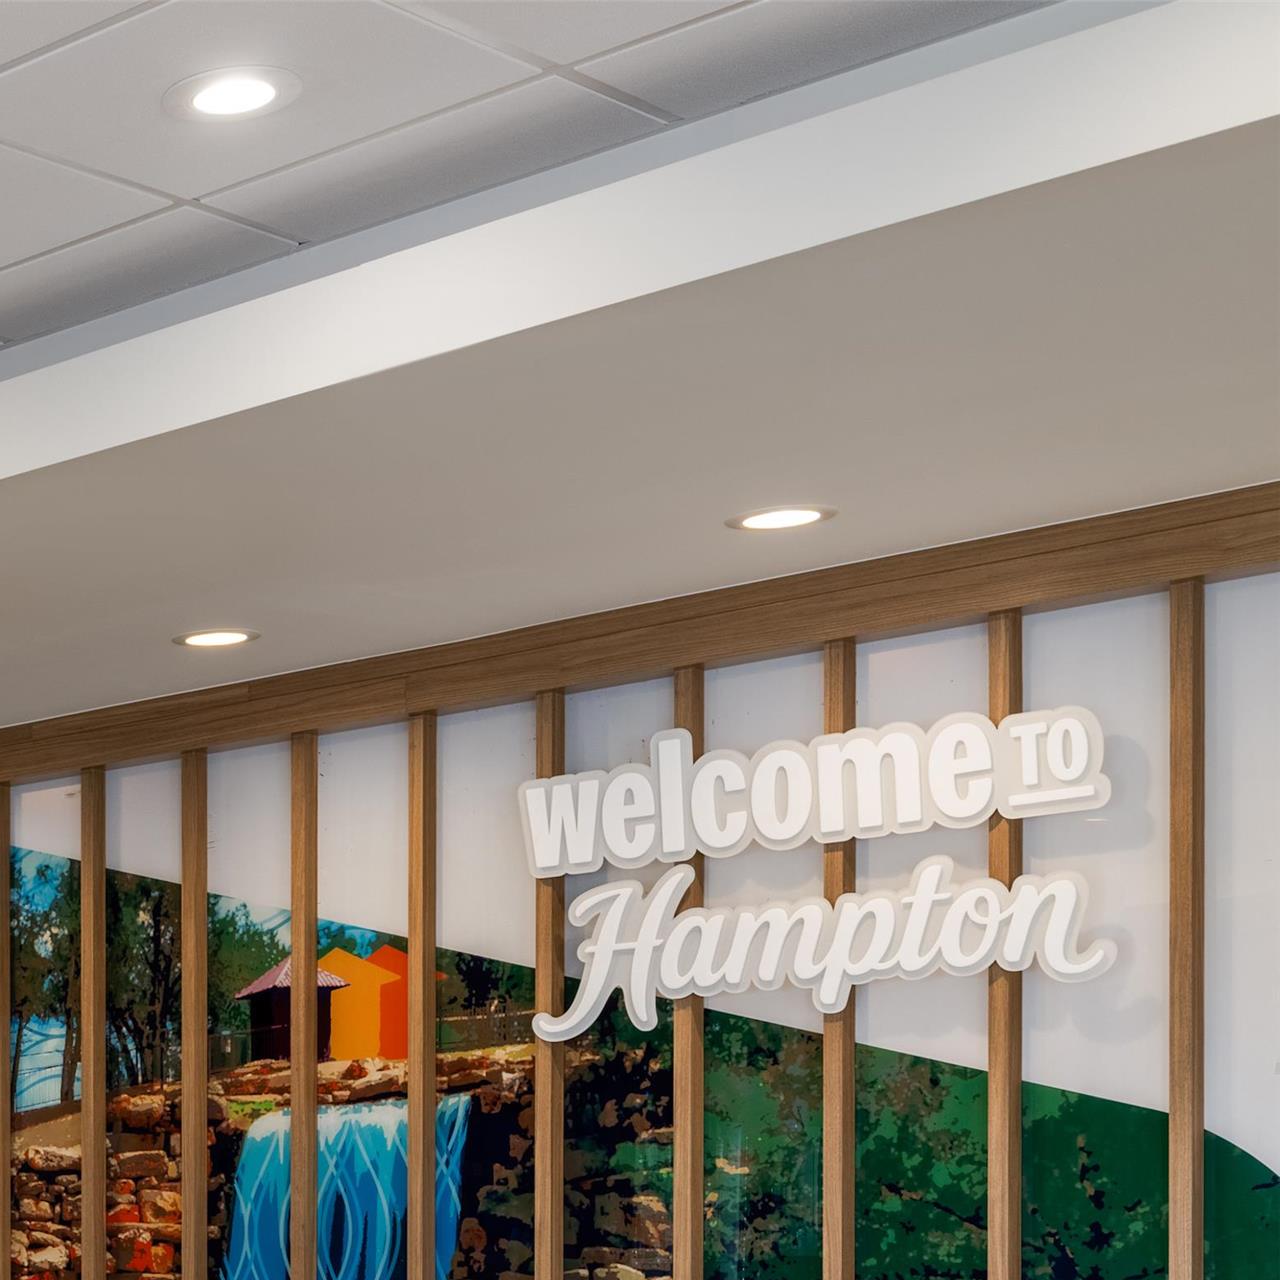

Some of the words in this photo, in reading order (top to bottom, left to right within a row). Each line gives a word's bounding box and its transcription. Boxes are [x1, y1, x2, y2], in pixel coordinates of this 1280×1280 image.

[524, 721, 995, 869] welcome
[1009, 717, 1090, 788] TO
[535, 862, 1106, 1035] Hampton
